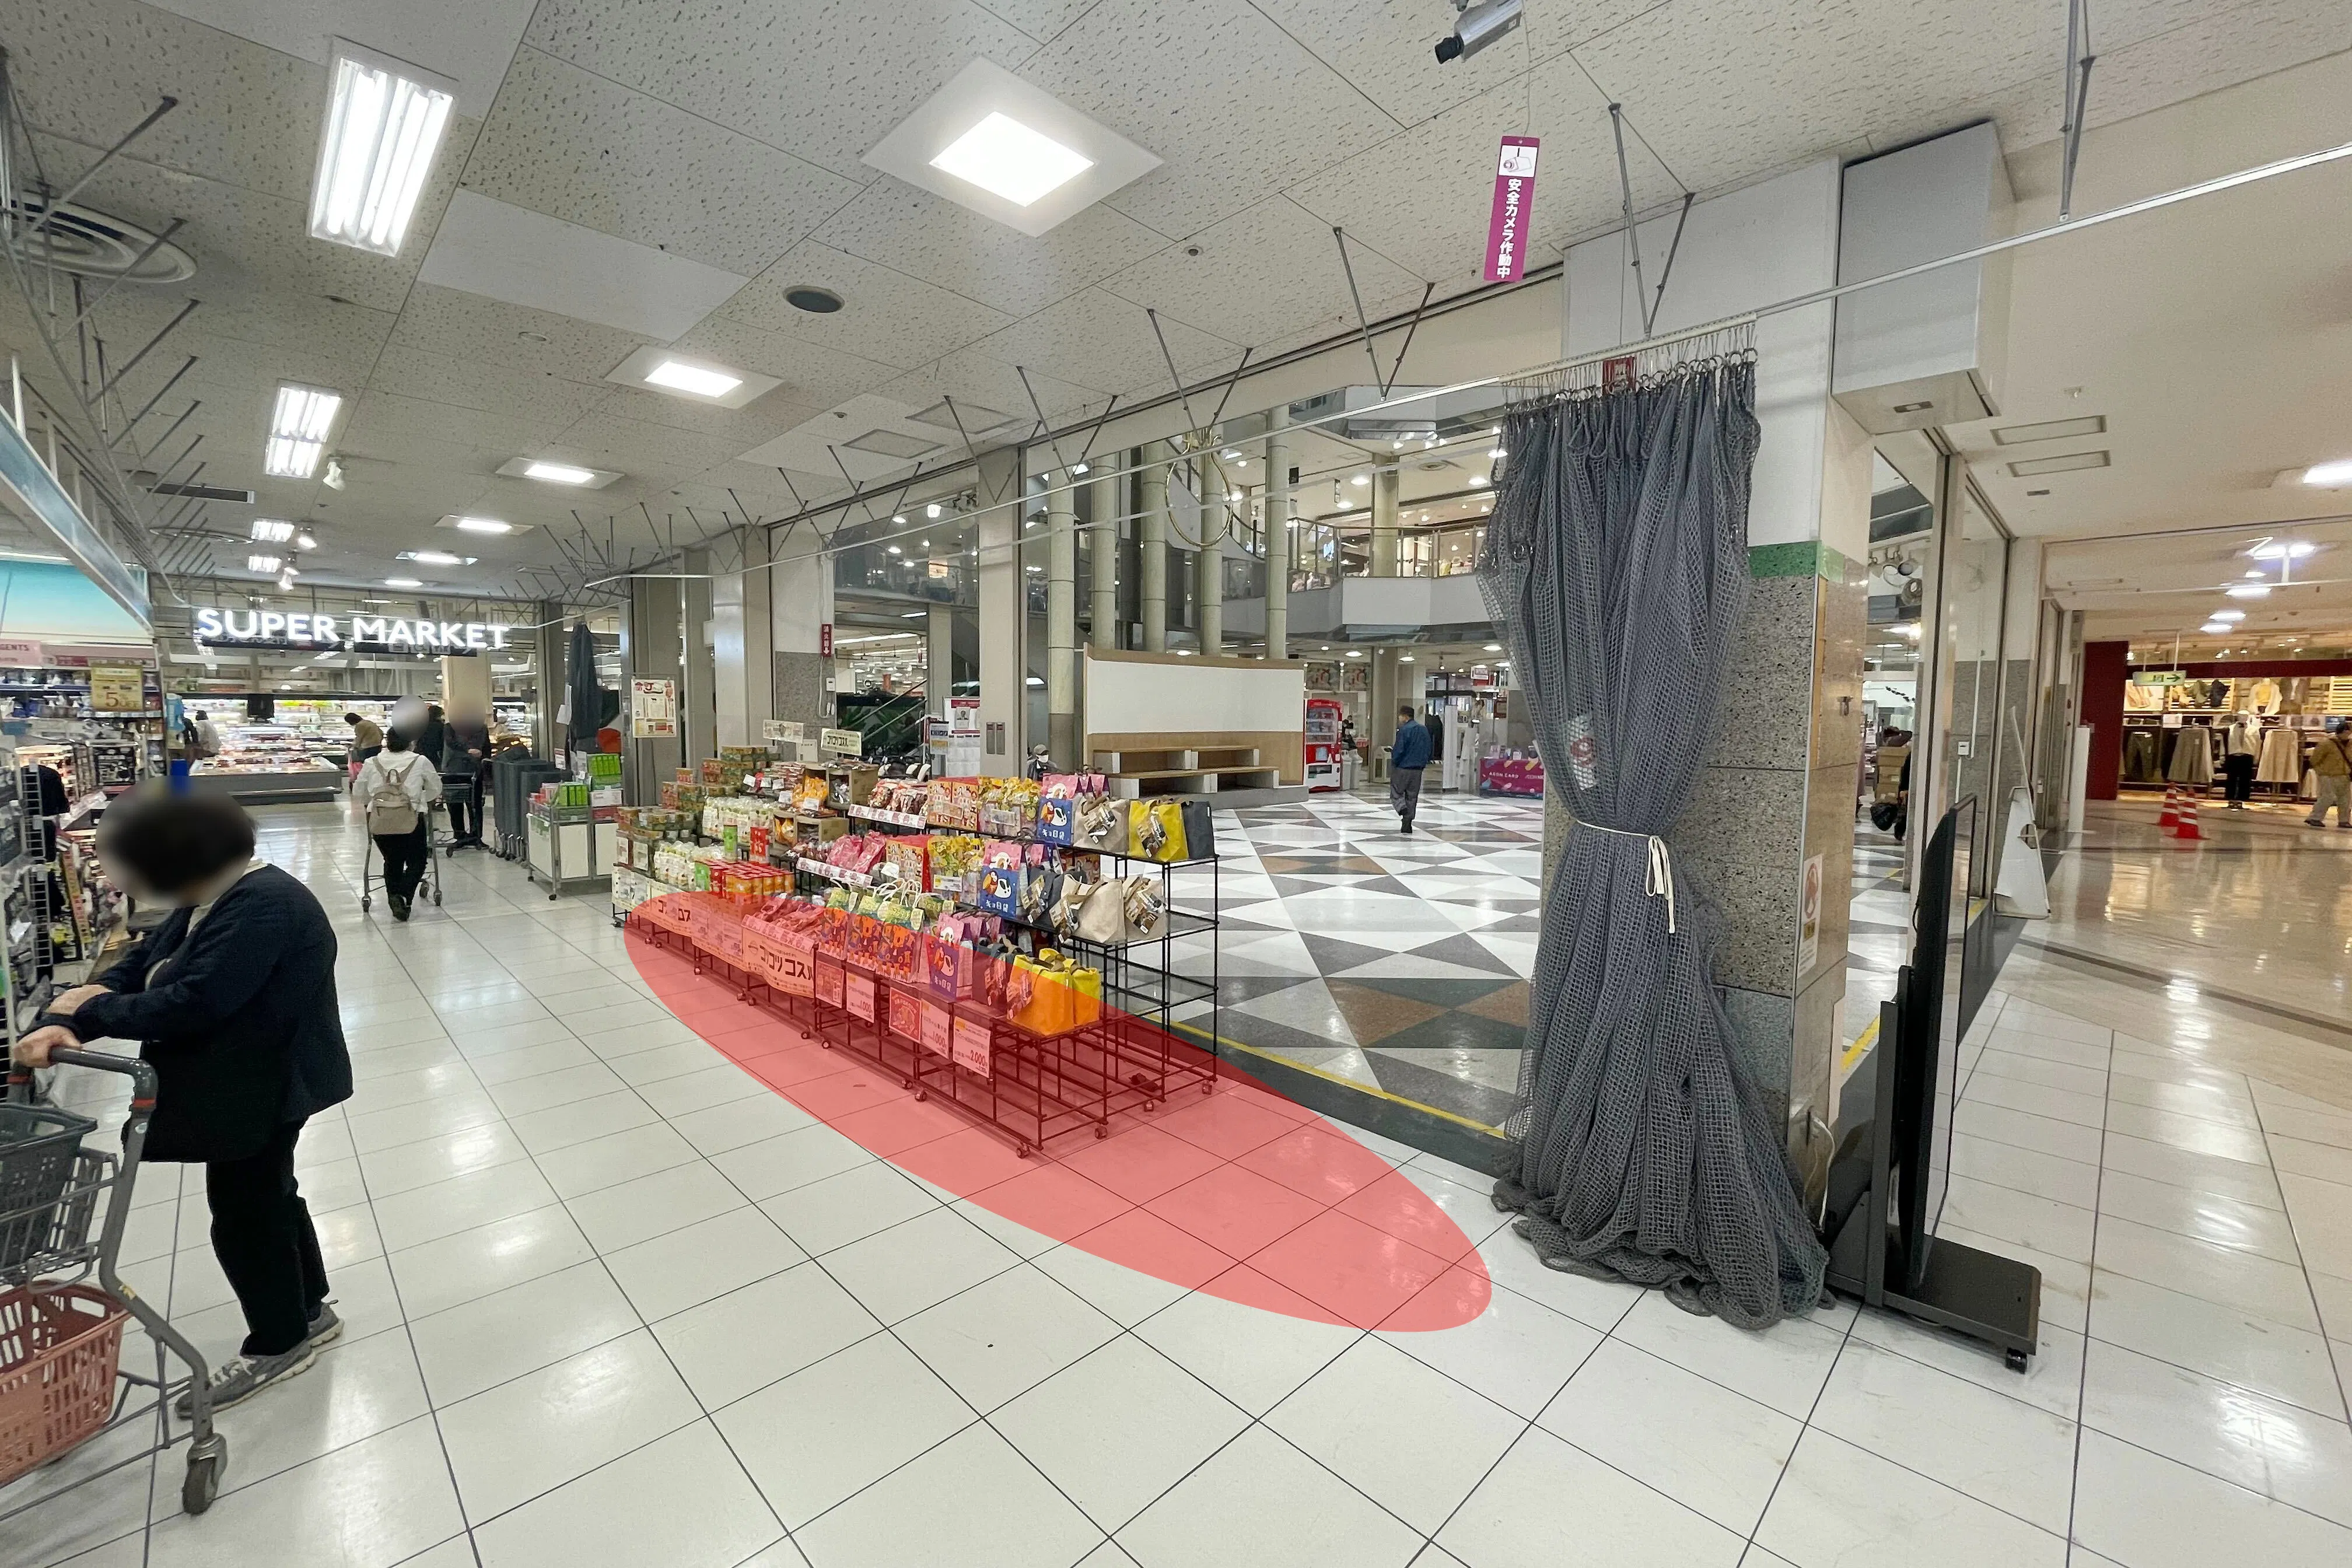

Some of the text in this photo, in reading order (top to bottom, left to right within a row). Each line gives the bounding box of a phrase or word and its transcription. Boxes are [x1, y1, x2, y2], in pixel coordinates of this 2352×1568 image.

[1497, 178, 1522, 279] 安全カメラ作動中
[197, 608, 341, 642] SUPER
[352, 616, 510, 649] MARKET
